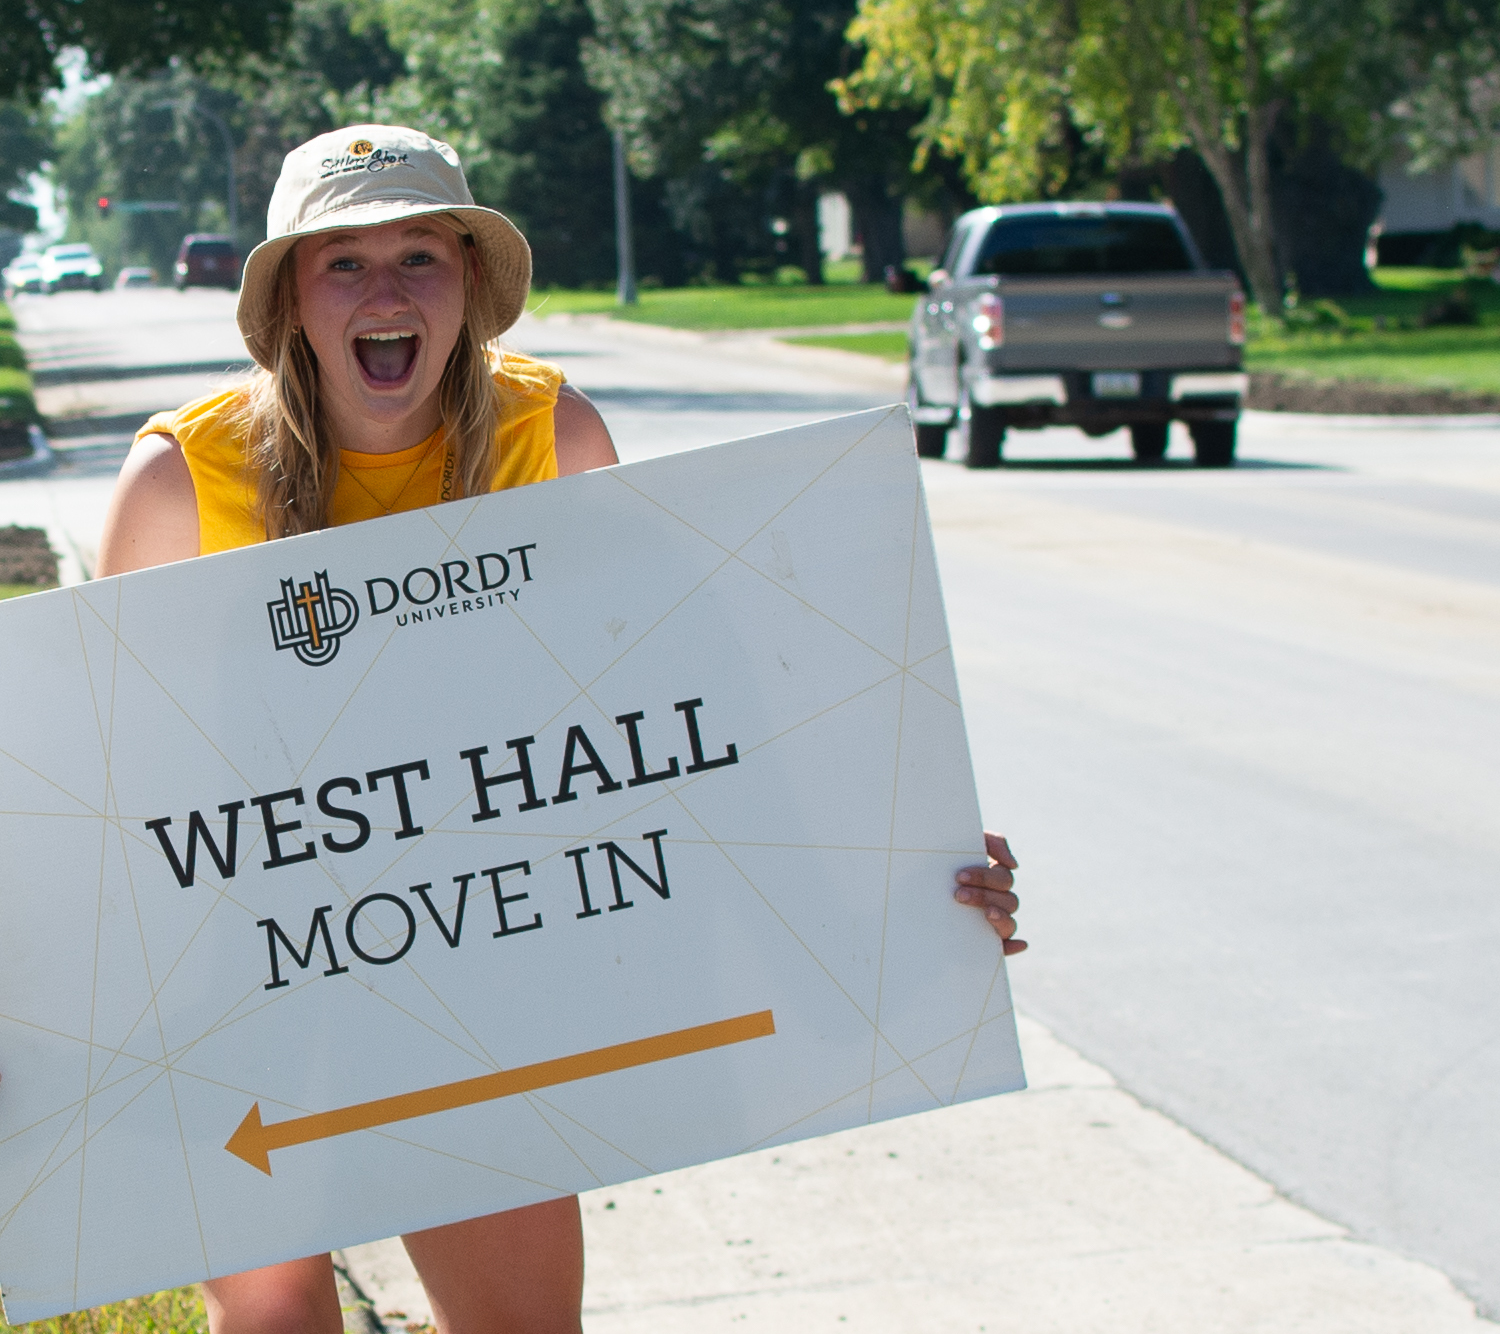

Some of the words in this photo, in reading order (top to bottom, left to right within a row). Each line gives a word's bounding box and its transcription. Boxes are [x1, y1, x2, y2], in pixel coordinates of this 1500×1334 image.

[363, 542, 537, 617] DORDT
[396, 588, 521, 627] UNIVERSITY
[145, 759, 431, 889] WEST
[459, 697, 739, 823] HALL
[256, 860, 543, 991] MOVE
[564, 828, 671, 920] IN
